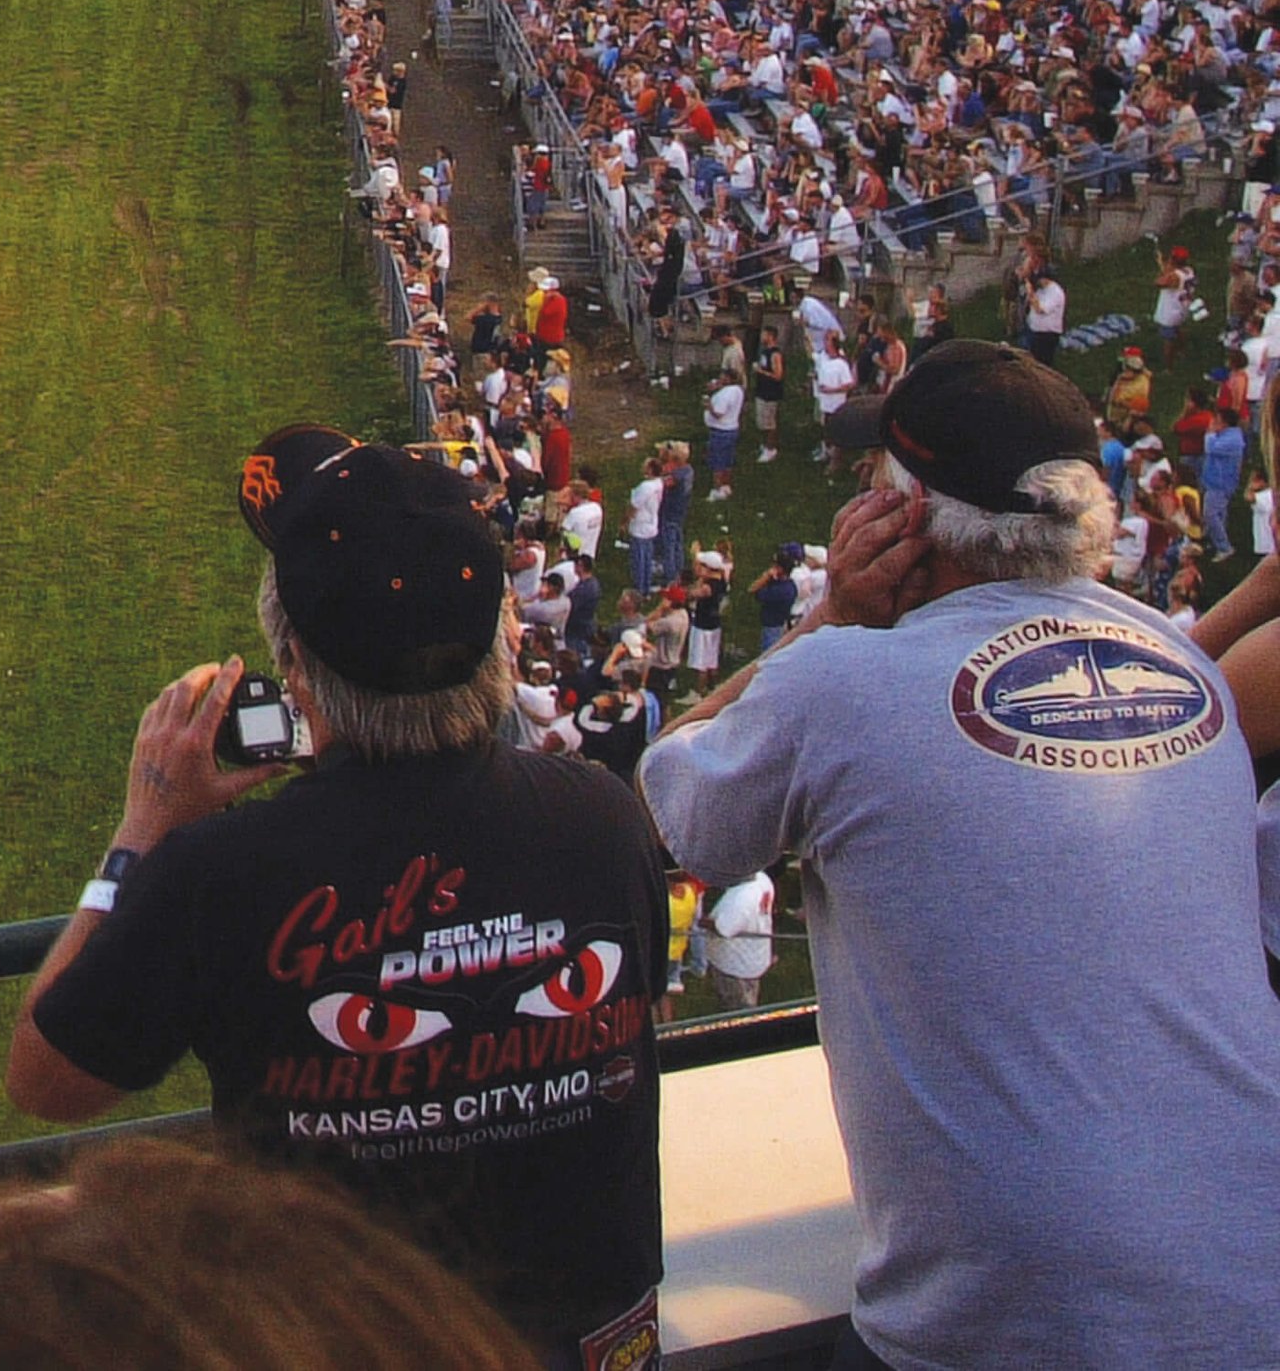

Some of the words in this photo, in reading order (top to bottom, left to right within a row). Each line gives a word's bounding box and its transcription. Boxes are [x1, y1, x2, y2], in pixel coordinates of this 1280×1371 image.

[1030, 708, 1113, 726] DEDICATED
[1116, 705, 1135, 718] TO
[1019, 728, 1203, 770] ASSOCIATION
[267, 852, 466, 989] Gail's
[423, 923, 481, 950] FEEL
[482, 912, 525, 938] THE
[380, 919, 566, 991] POWER
[260, 996, 651, 1101] HARLEY-DAVIDSON
[288, 1102, 442, 1139] KANSAS
[453, 1083, 536, 1123] CITY,
[543, 1069, 590, 1105] MO
[351, 1103, 593, 1162] feelthepower.com
